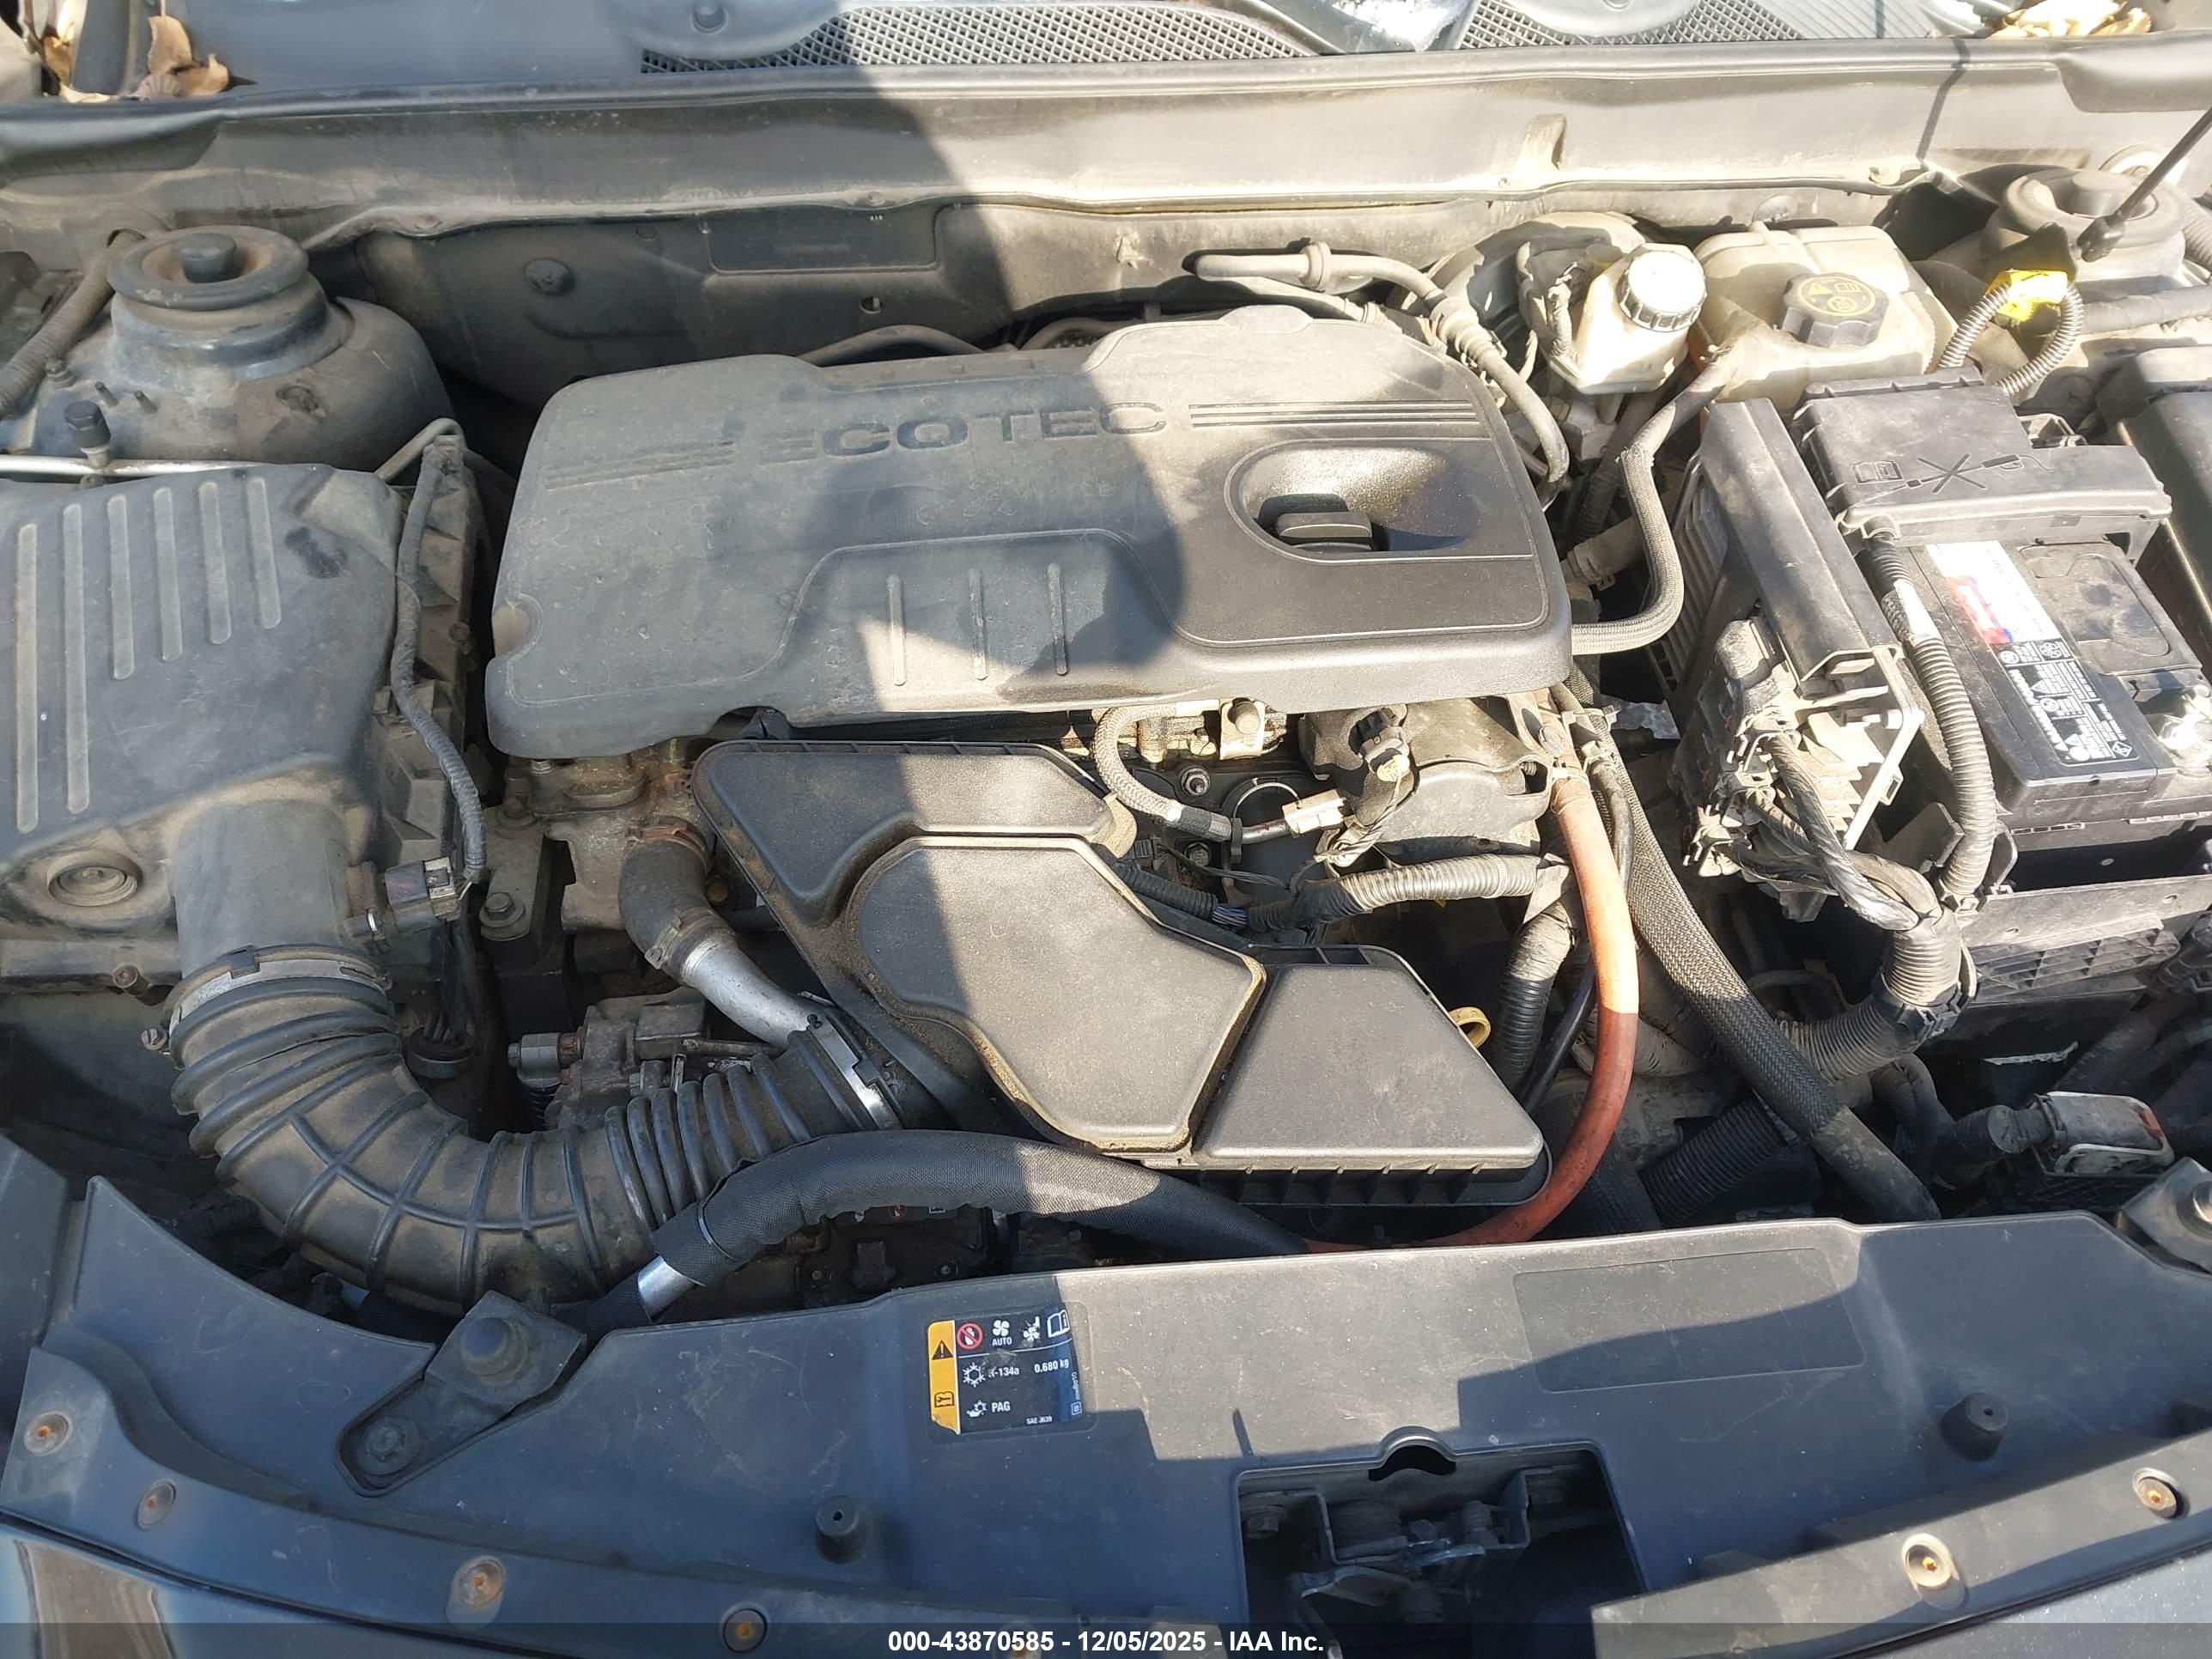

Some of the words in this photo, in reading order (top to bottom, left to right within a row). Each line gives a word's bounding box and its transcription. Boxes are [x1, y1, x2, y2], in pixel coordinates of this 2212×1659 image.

[759, 402, 1168, 465] ECOTEC
[992, 1337, 1012, 1346] AUTO
[1034, 1361, 1058, 1373] 0.680
[1060, 1358, 1069, 1370] kg
[991, 1401, 1011, 1413] PAG
